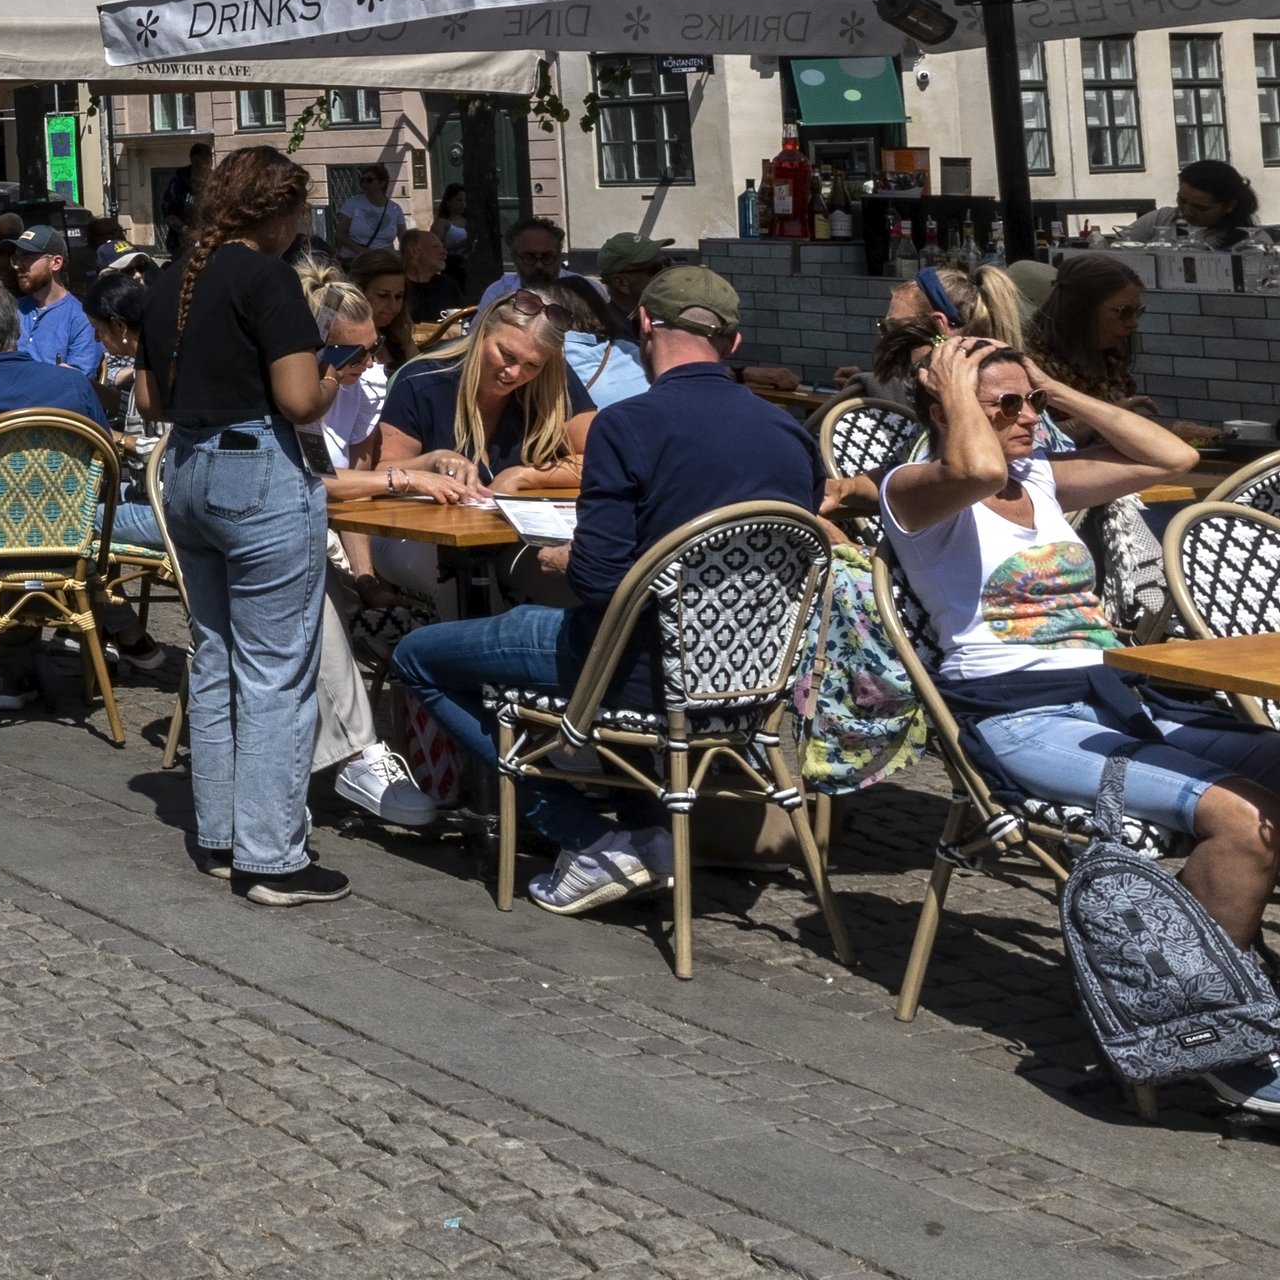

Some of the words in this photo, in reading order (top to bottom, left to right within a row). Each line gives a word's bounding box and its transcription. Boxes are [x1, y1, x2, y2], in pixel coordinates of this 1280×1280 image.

[137, 63, 203, 75] SANDWICH
[207, 64, 216, 75] &
[219, 65, 251, 76] CAFE
